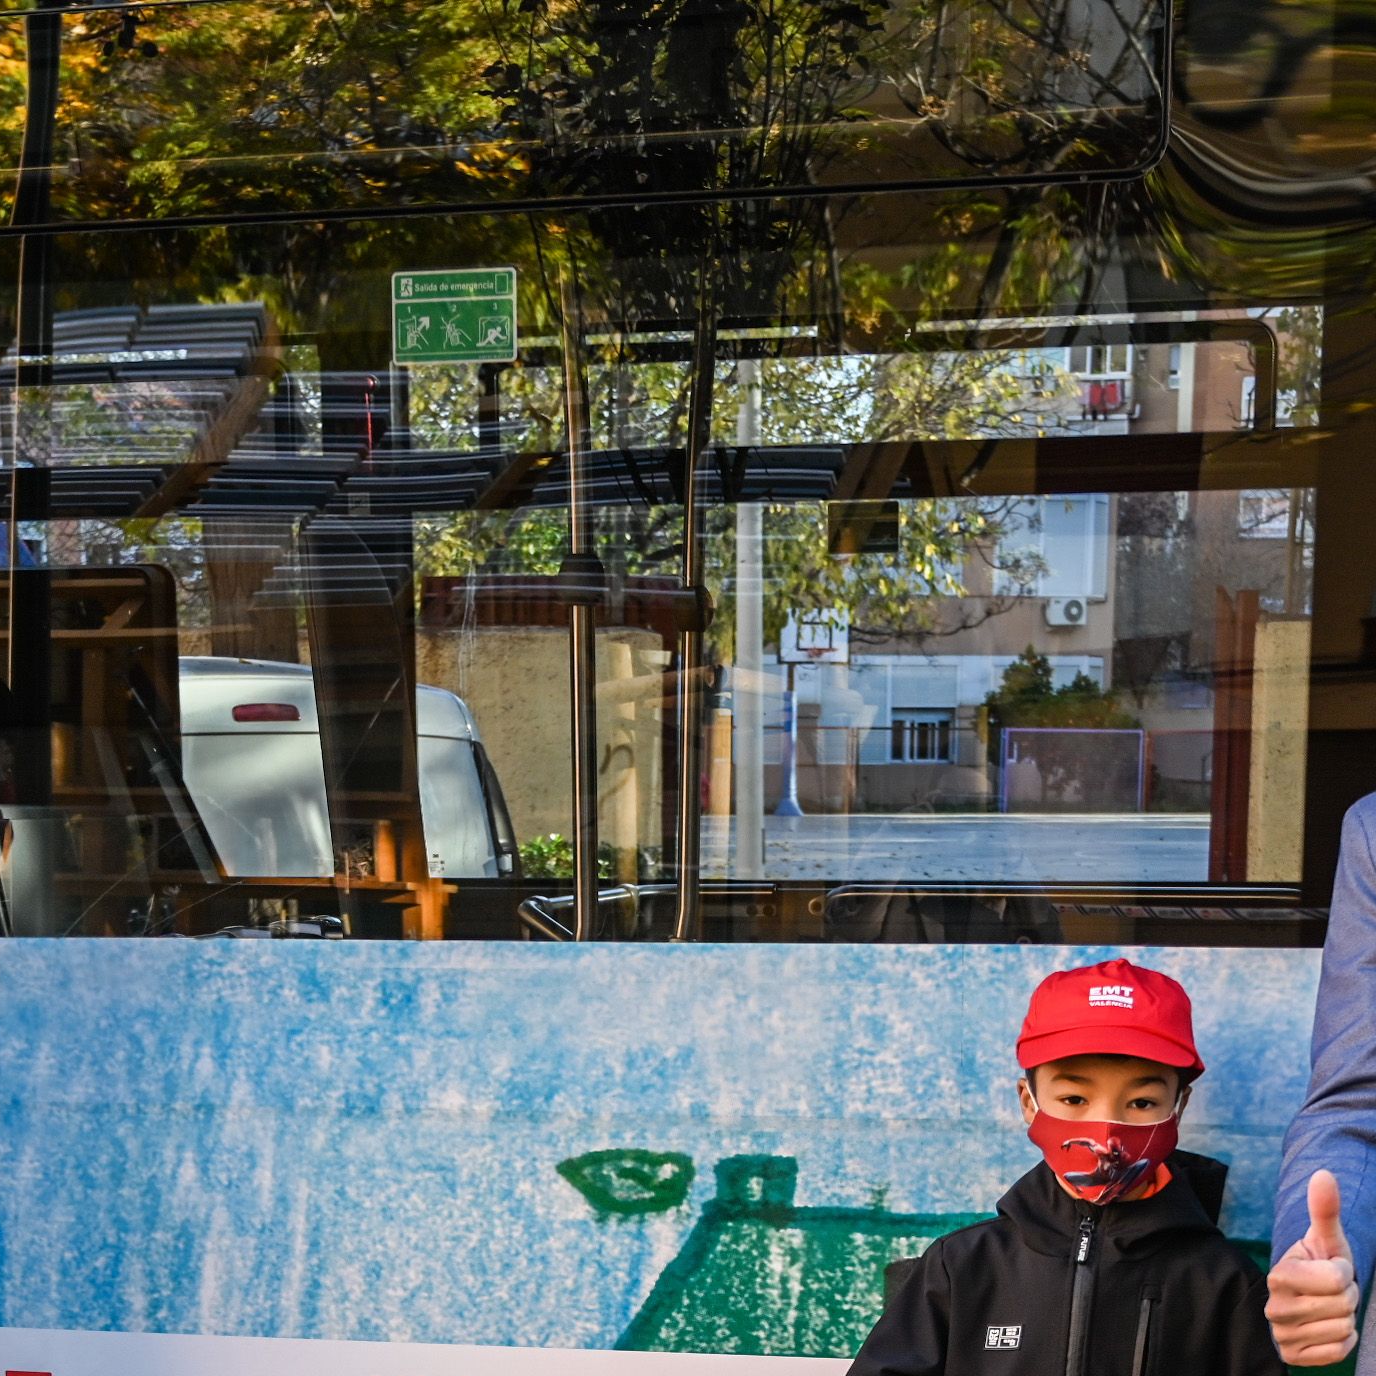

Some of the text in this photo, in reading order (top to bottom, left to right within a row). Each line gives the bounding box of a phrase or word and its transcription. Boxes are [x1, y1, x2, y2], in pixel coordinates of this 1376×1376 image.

[414, 283, 437, 292] Salida
[450, 281, 494, 293] emergencia
[1088, 985, 1134, 998] EMT
